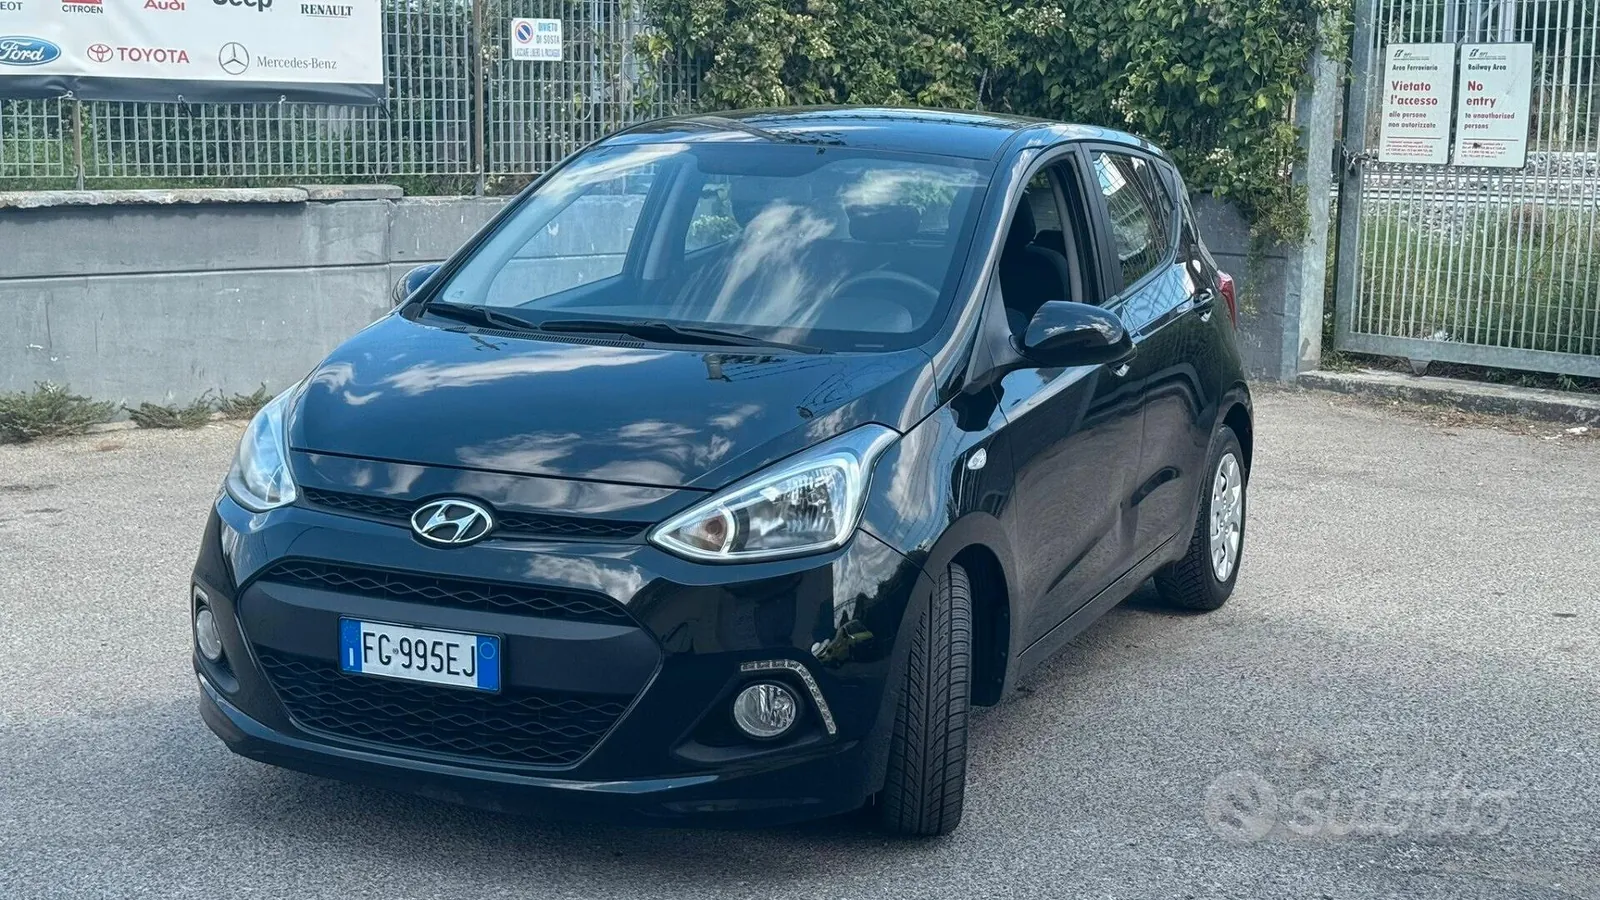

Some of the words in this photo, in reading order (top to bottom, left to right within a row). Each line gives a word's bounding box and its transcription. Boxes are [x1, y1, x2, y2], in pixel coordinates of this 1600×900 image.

[144, 0, 185, 11] Audi
[300, 3, 353, 16] RENAULT
[0, 40, 45, 61] Ford
[117, 47, 190, 64] TOYOTA
[256, 55, 338, 71] Mercedes-Benz
[1468, 63, 1491, 72] Railway
[1391, 80, 1431, 91] Vietato
[1468, 81, 1483, 91] No
[1390, 94, 1438, 106] l'accesso
[1466, 96, 1496, 108] entry
[1402, 112, 1427, 120] persone
[1464, 122, 1489, 131] persons
[362, 631, 392, 666] FG
[399, 636, 476, 678] 995EJ
